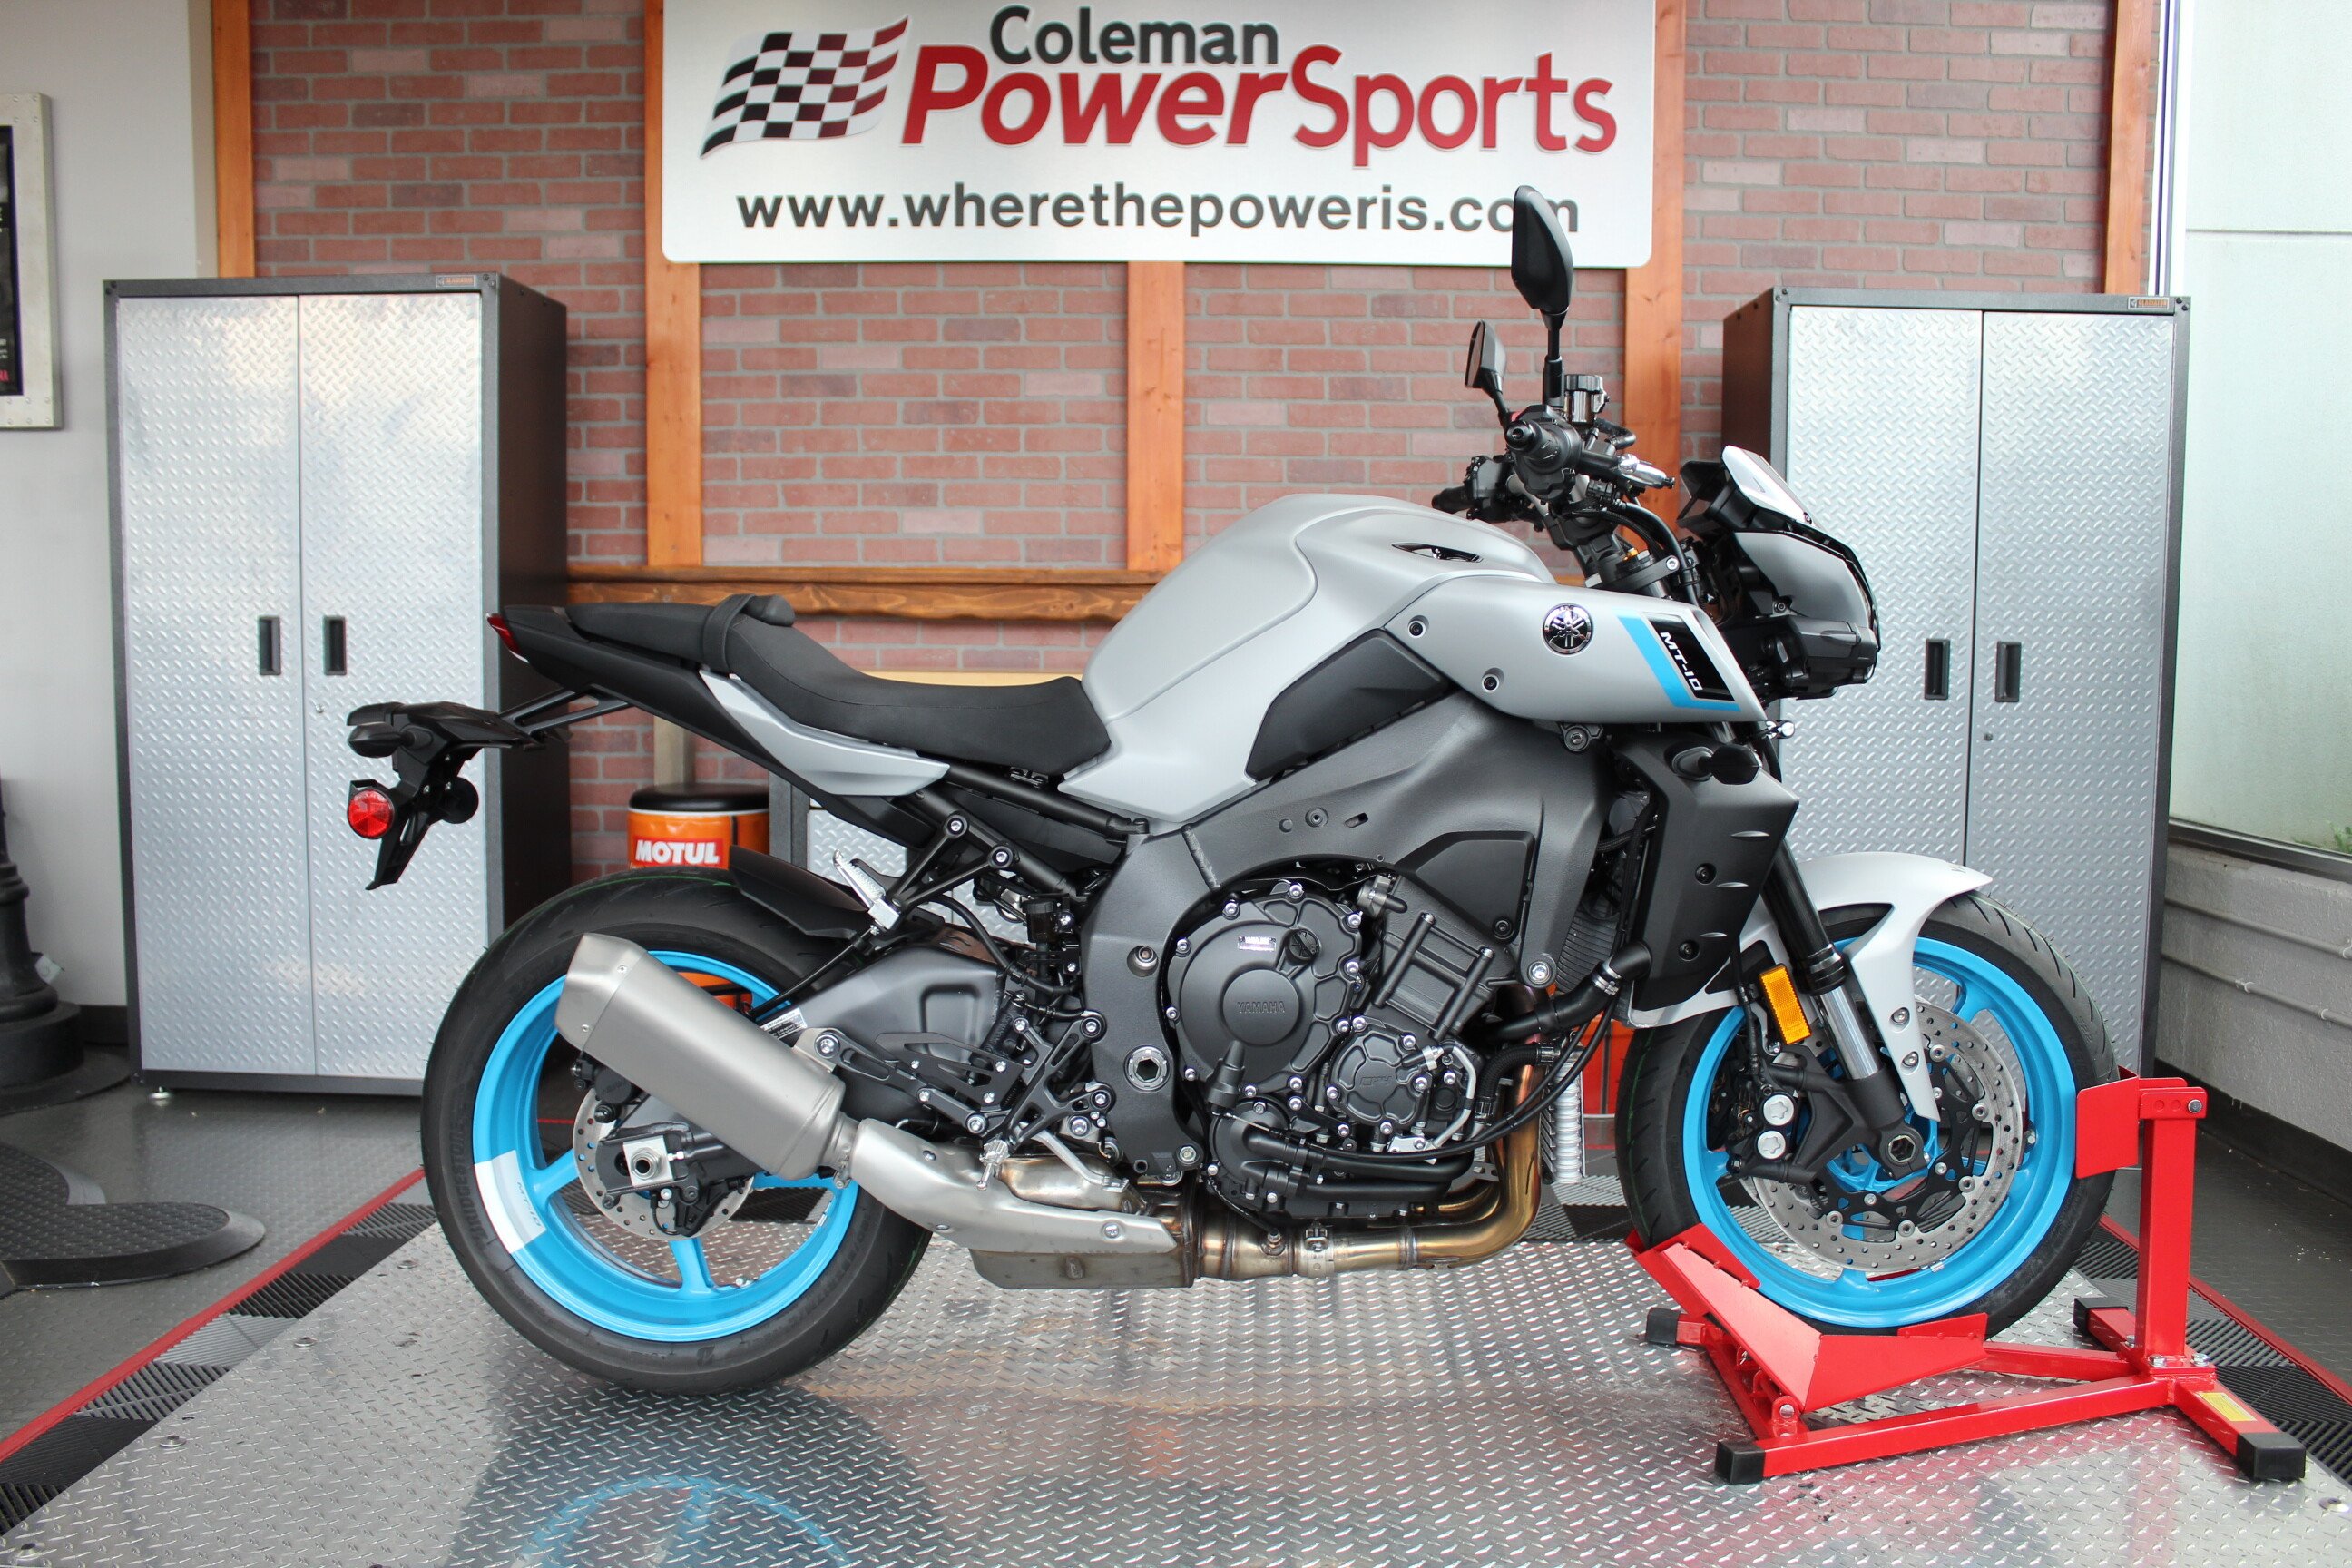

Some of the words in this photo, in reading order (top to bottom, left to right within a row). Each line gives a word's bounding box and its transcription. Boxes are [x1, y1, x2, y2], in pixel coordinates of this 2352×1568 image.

[988, 4, 1279, 65] Coleman
[901, 44, 1617, 168] PowerSports
[737, 181, 1579, 238] www.wherethepoweris.com
[1659, 631, 1704, 691] MT-10
[635, 839, 720, 864] MOTUL
[1237, 1000, 1286, 1014] YAMAHA
[516, 1181, 544, 1228] MT-10
